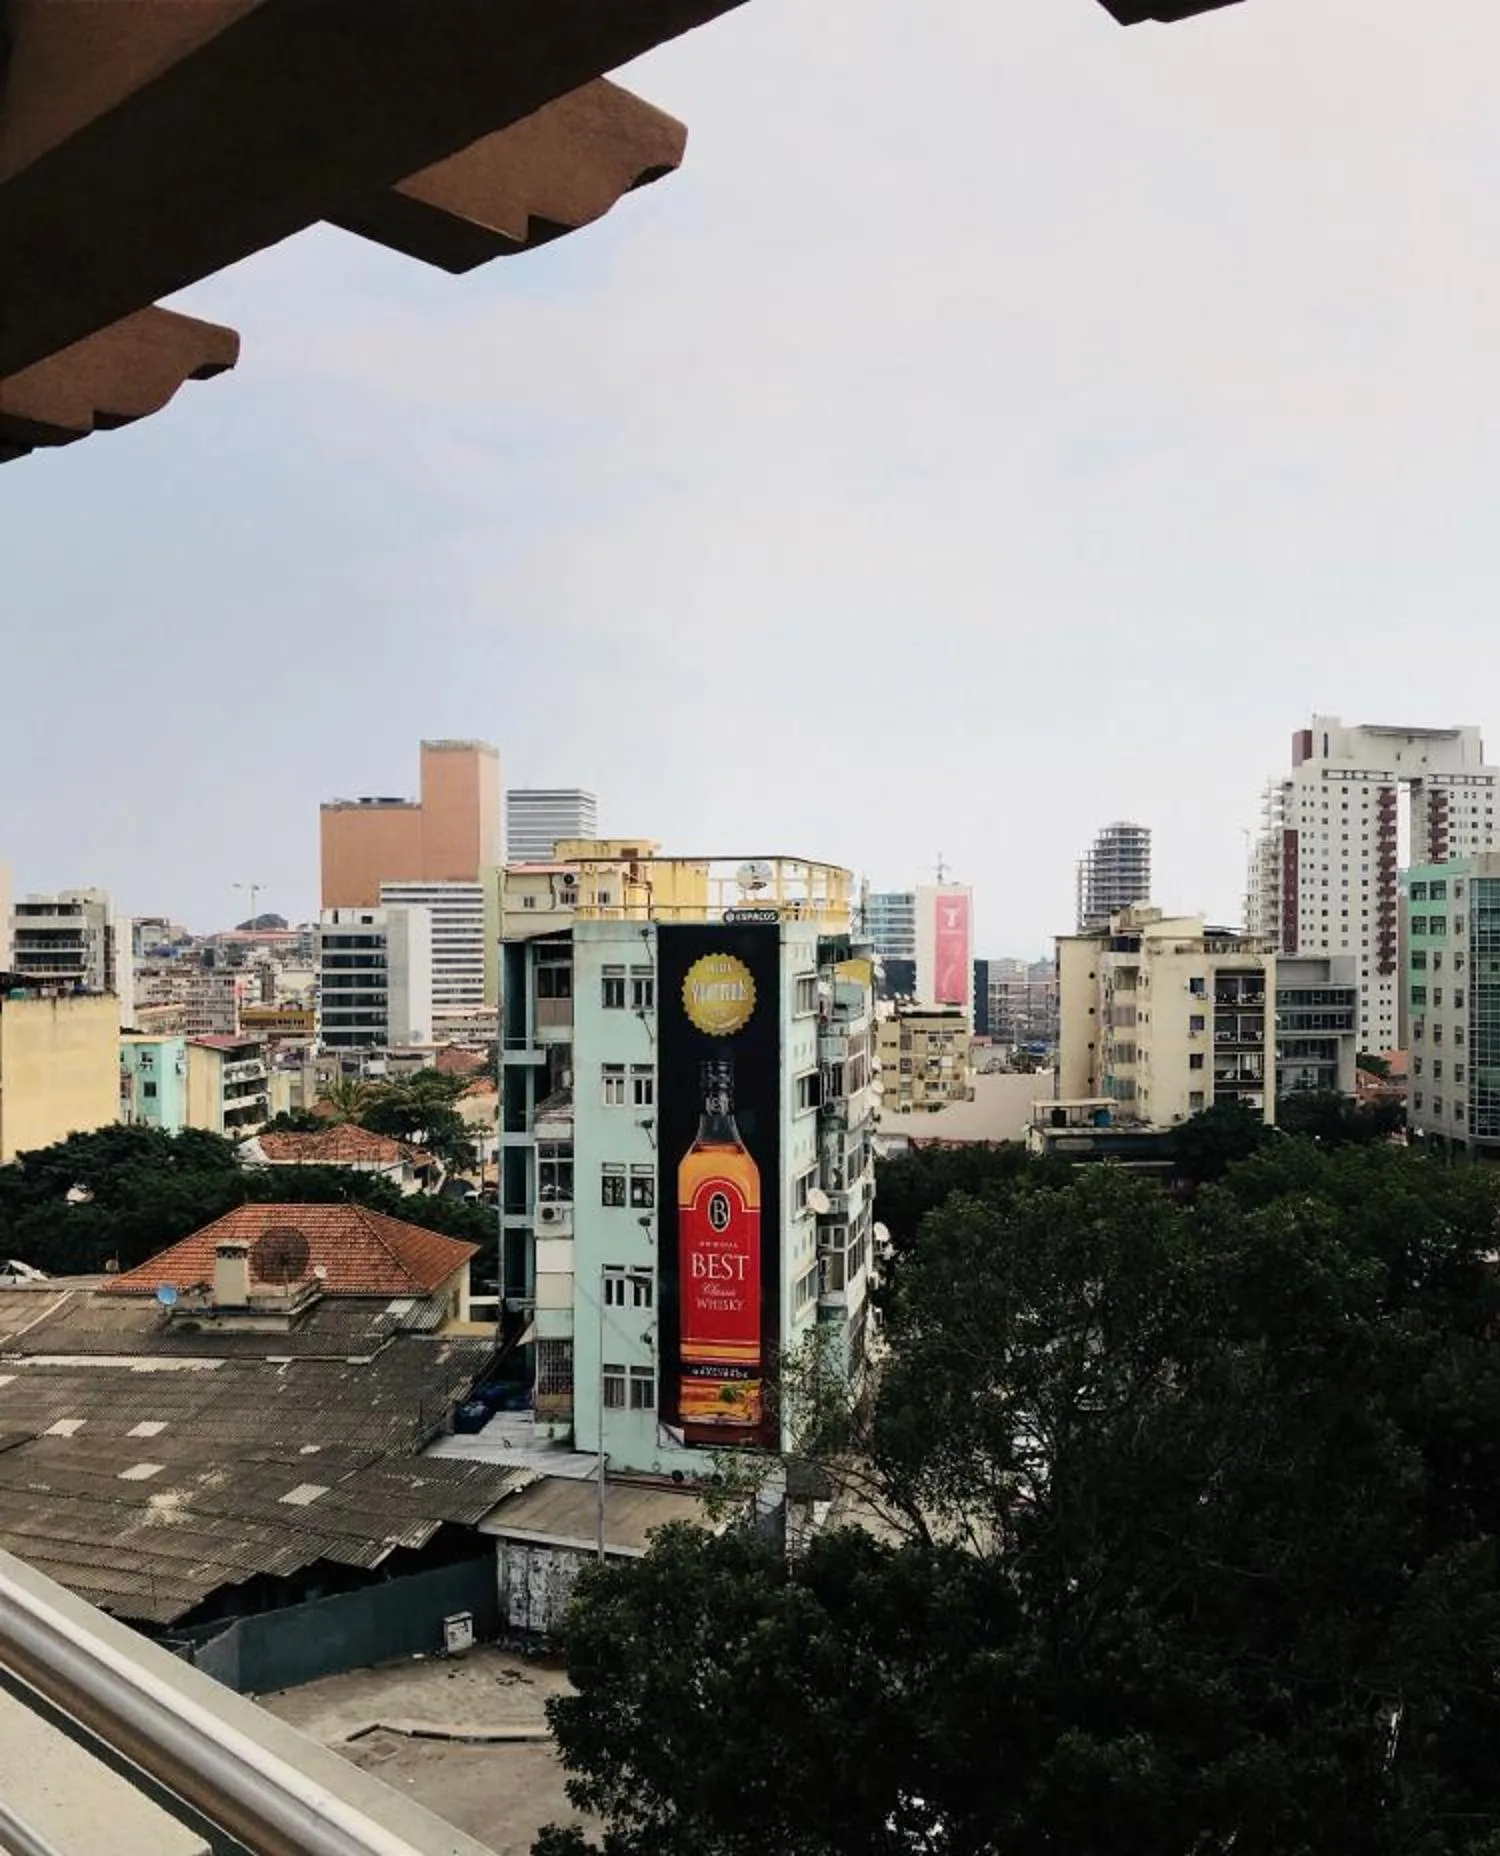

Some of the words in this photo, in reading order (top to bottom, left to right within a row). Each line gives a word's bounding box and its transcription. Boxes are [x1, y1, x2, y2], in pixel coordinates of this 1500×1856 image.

[713, 1199, 727, 1225] B
[692, 1252, 750, 1281] BEST
[696, 1298, 744, 1312] WHISKY
